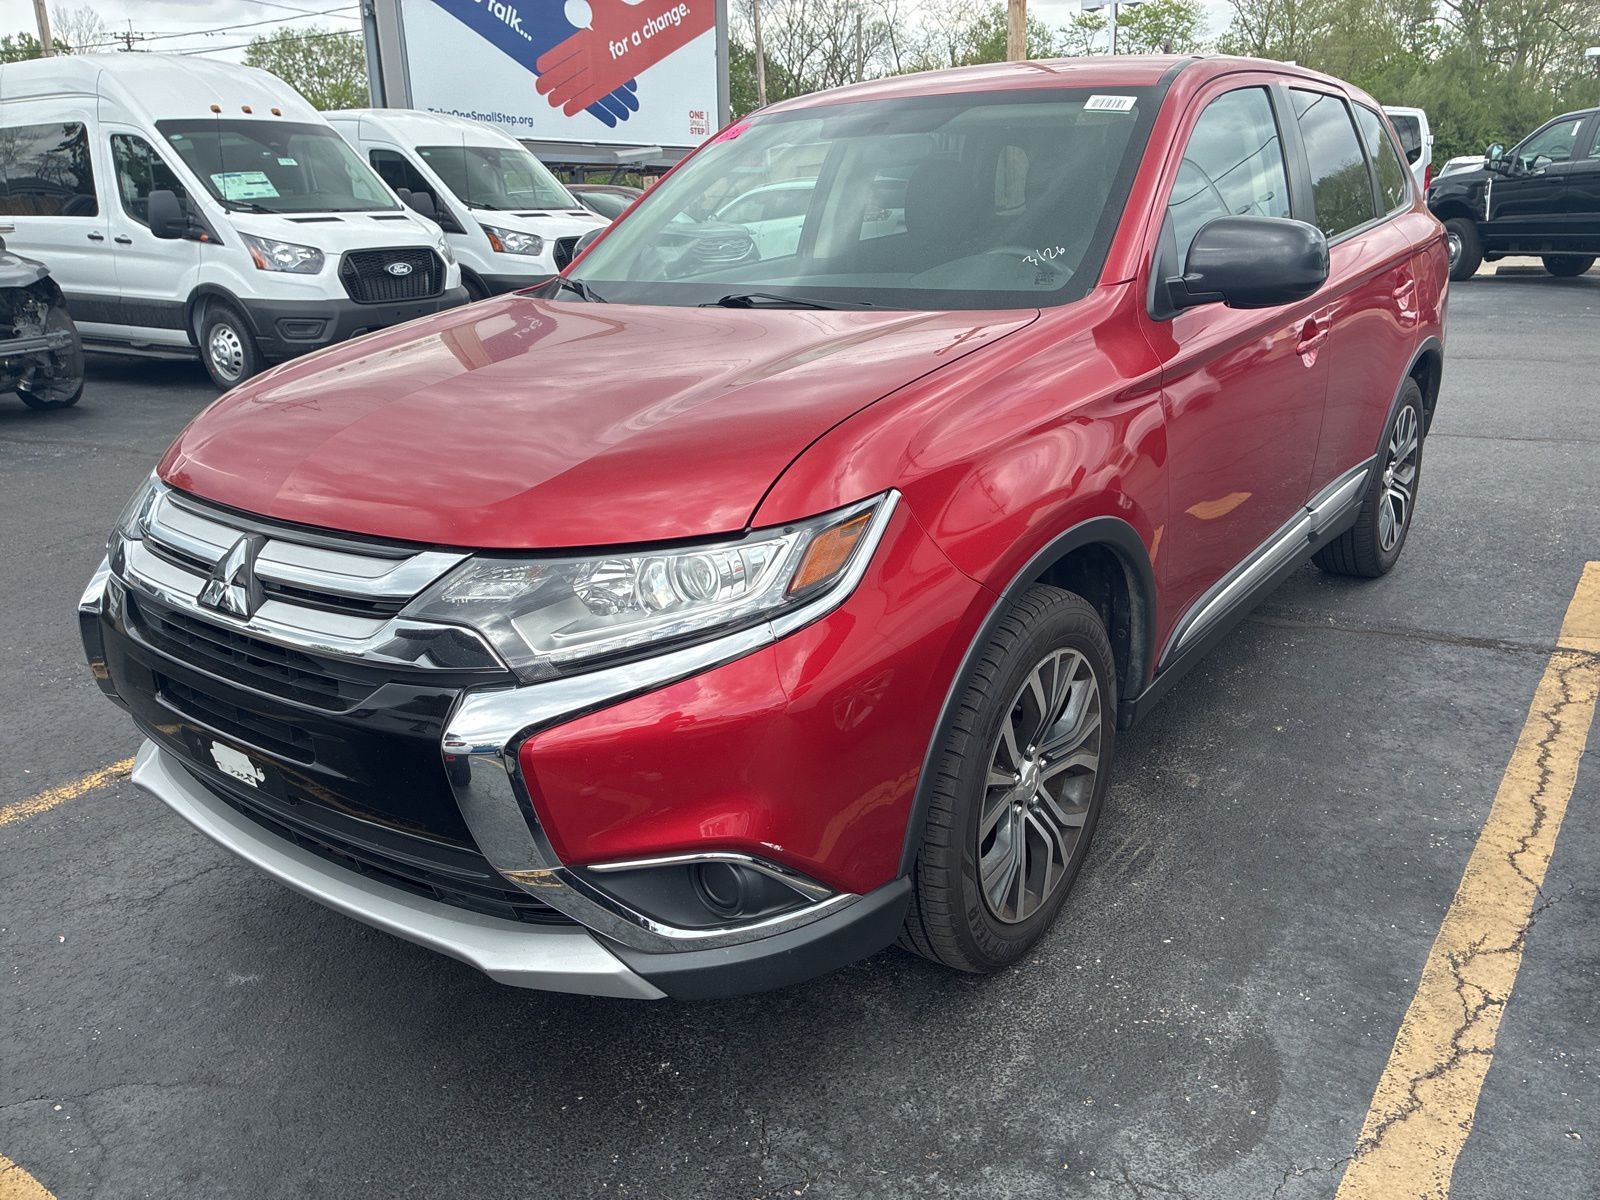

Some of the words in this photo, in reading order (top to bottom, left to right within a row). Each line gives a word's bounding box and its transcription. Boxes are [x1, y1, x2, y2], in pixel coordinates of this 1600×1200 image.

[608, 37, 628, 60] for
[631, 30, 642, 46] a
[642, 2, 691, 39] change.
[427, 107, 534, 127] OneSmallStep.org
[689, 110, 704, 120] ONE
[690, 127, 705, 135] STEP
[391, 264, 410, 274] Ford
